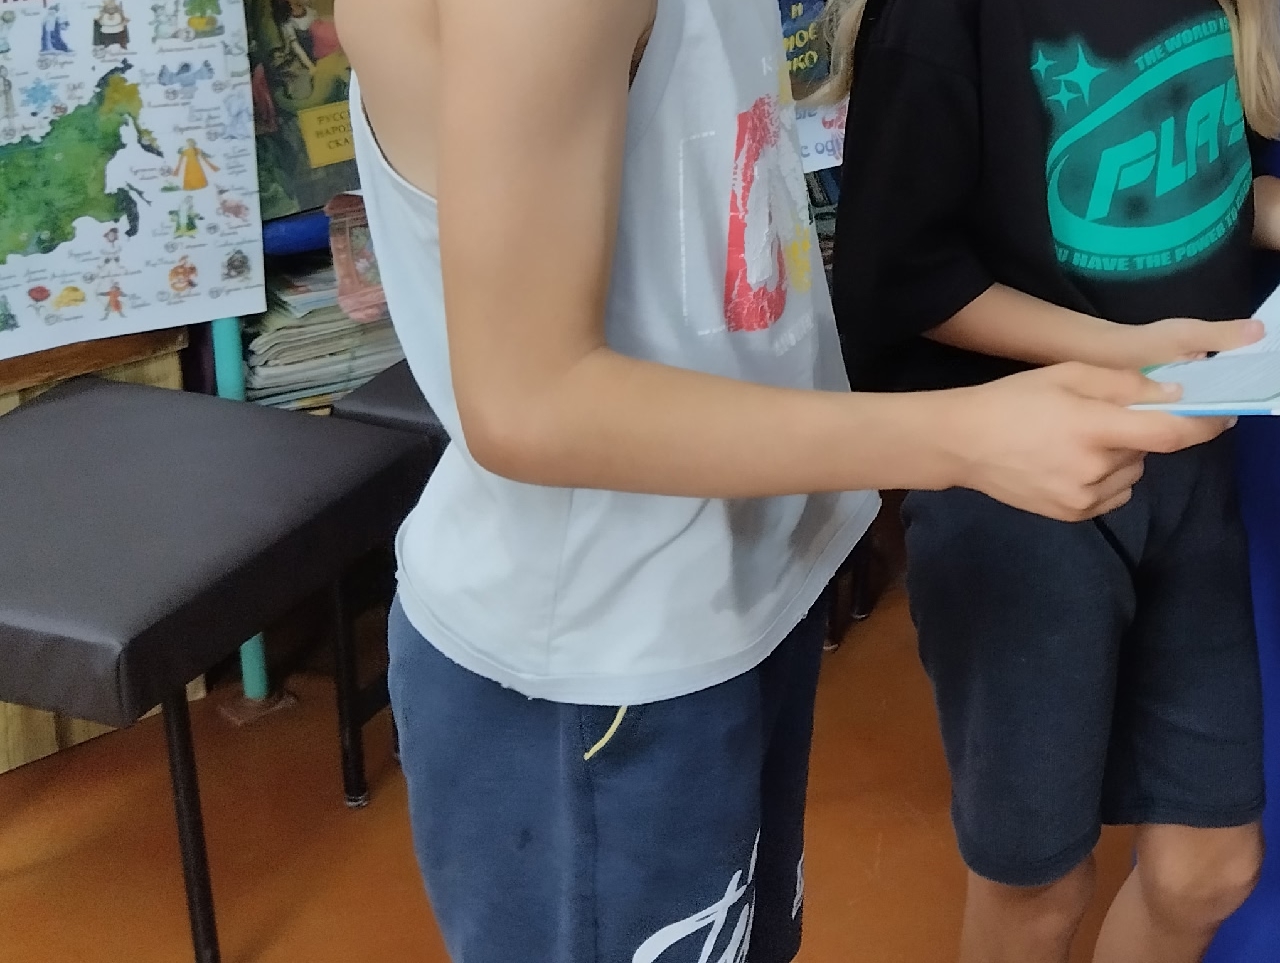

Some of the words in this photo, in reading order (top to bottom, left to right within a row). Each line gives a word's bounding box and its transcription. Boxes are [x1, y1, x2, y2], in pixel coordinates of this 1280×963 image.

[1134, 47, 1165, 71] THE
[1165, 19, 1219, 53] WORLD
[315, 124, 351, 139] НАРО
[1073, 252, 1129, 271] HAVE
[1135, 252, 1172, 270] THE
[1174, 226, 1230, 263] POWER
